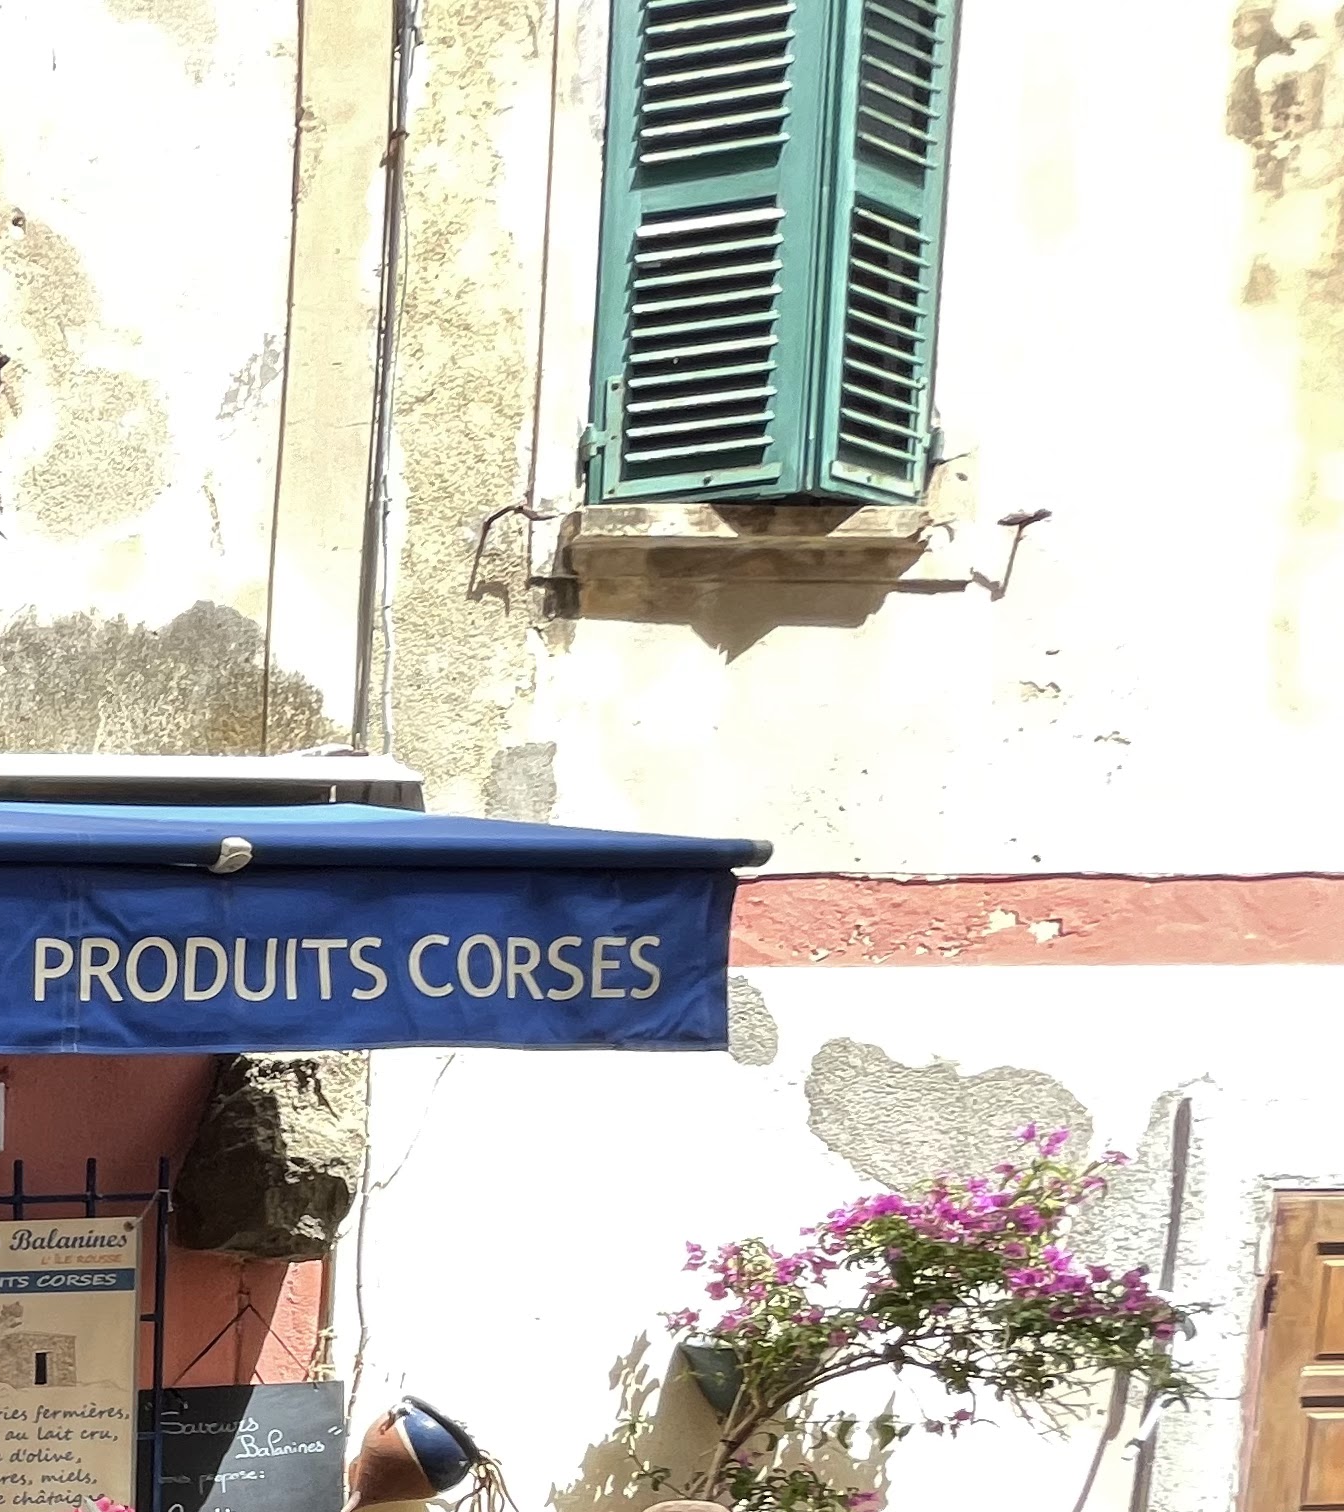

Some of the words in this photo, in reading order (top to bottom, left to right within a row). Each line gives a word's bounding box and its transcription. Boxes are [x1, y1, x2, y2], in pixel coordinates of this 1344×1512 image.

[32, 935, 388, 1003] PRODUITS
[407, 933, 662, 1000] CORSES
[8, 1228, 128, 1251] Balanines
[75, 1253, 123, 1264] ROUSSE
[36, 1273, 117, 1288] CORSES
[31, 1402, 131, 1424] fermières,
[4, 1431, 29, 1441] au
[37, 1427, 74, 1442] lait
[79, 1429, 119, 1442] cru,
[9, 1448, 82, 1465] d'olive,
[40, 1469, 98, 1485] miels,
